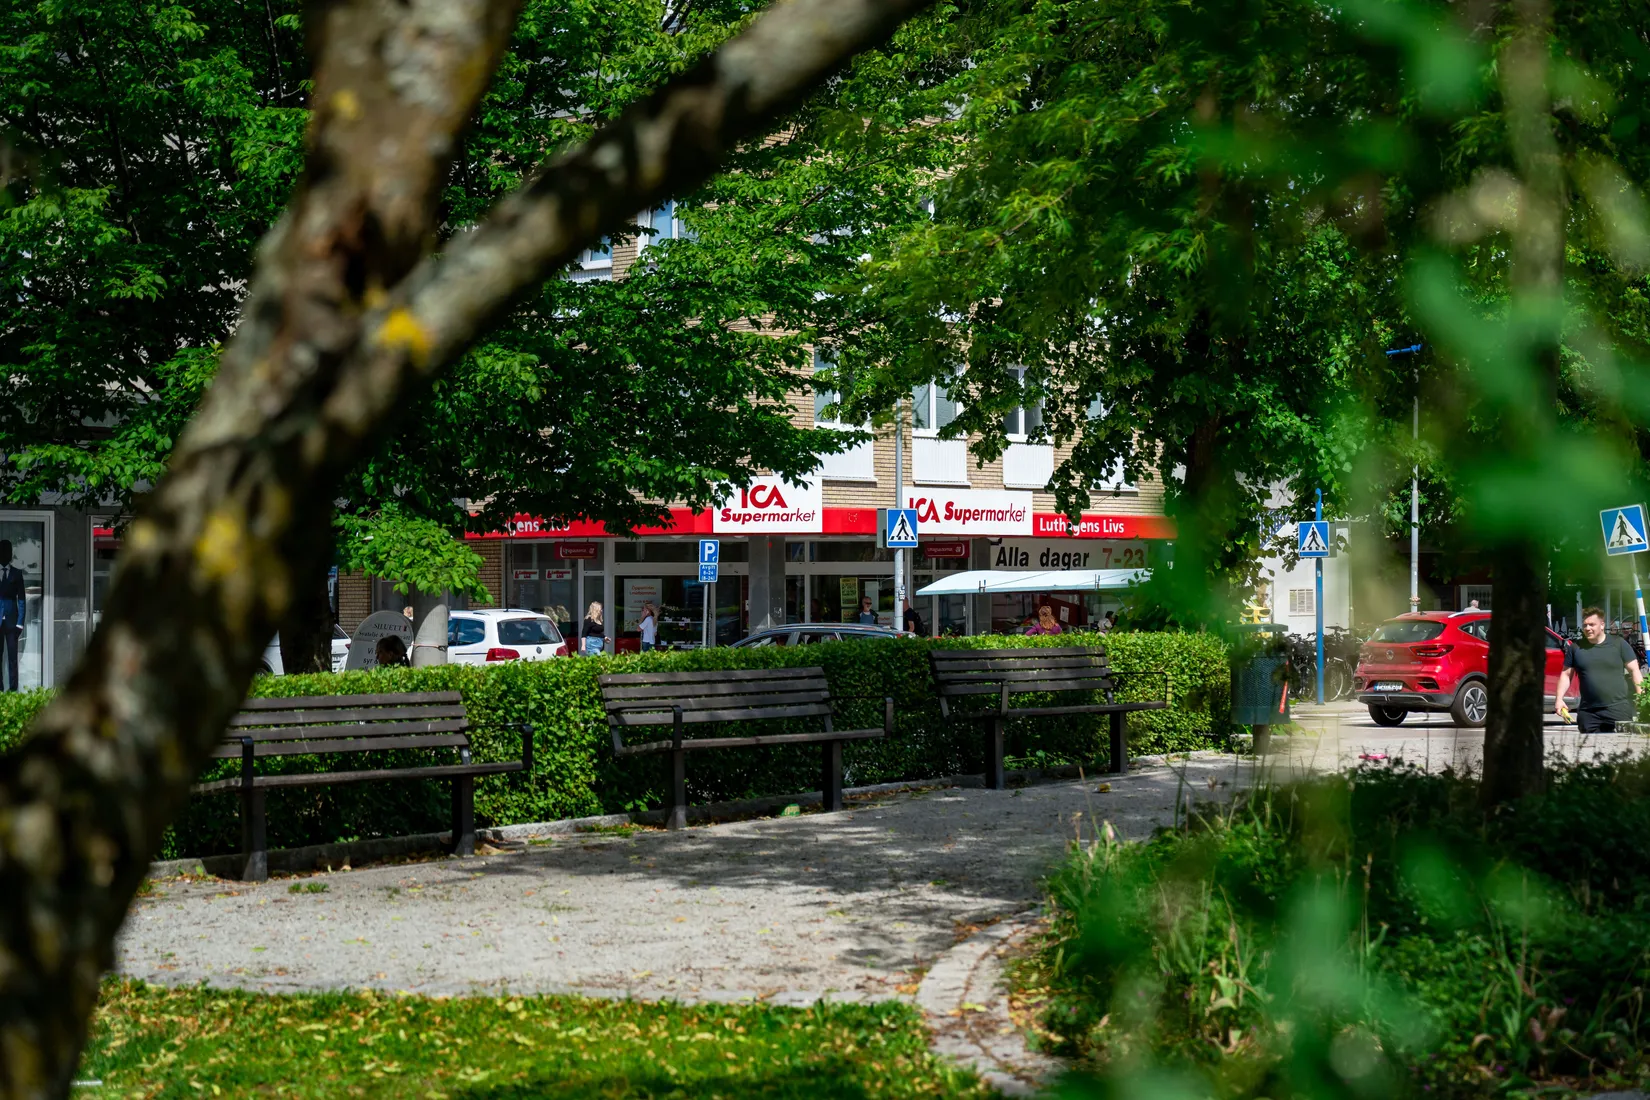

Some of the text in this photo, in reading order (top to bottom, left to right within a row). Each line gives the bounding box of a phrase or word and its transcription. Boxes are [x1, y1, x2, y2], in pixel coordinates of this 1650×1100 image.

[741, 485, 789, 509] ICA
[720, 507, 816, 526] Supermarket
[943, 501, 1027, 526] Supermarket
[1103, 518, 1125, 534] Livs
[704, 542, 716, 562] P
[995, 546, 1030, 567] Alla
[1039, 547, 1090, 570] dagar
[1102, 547, 1145, 569] 7-23
